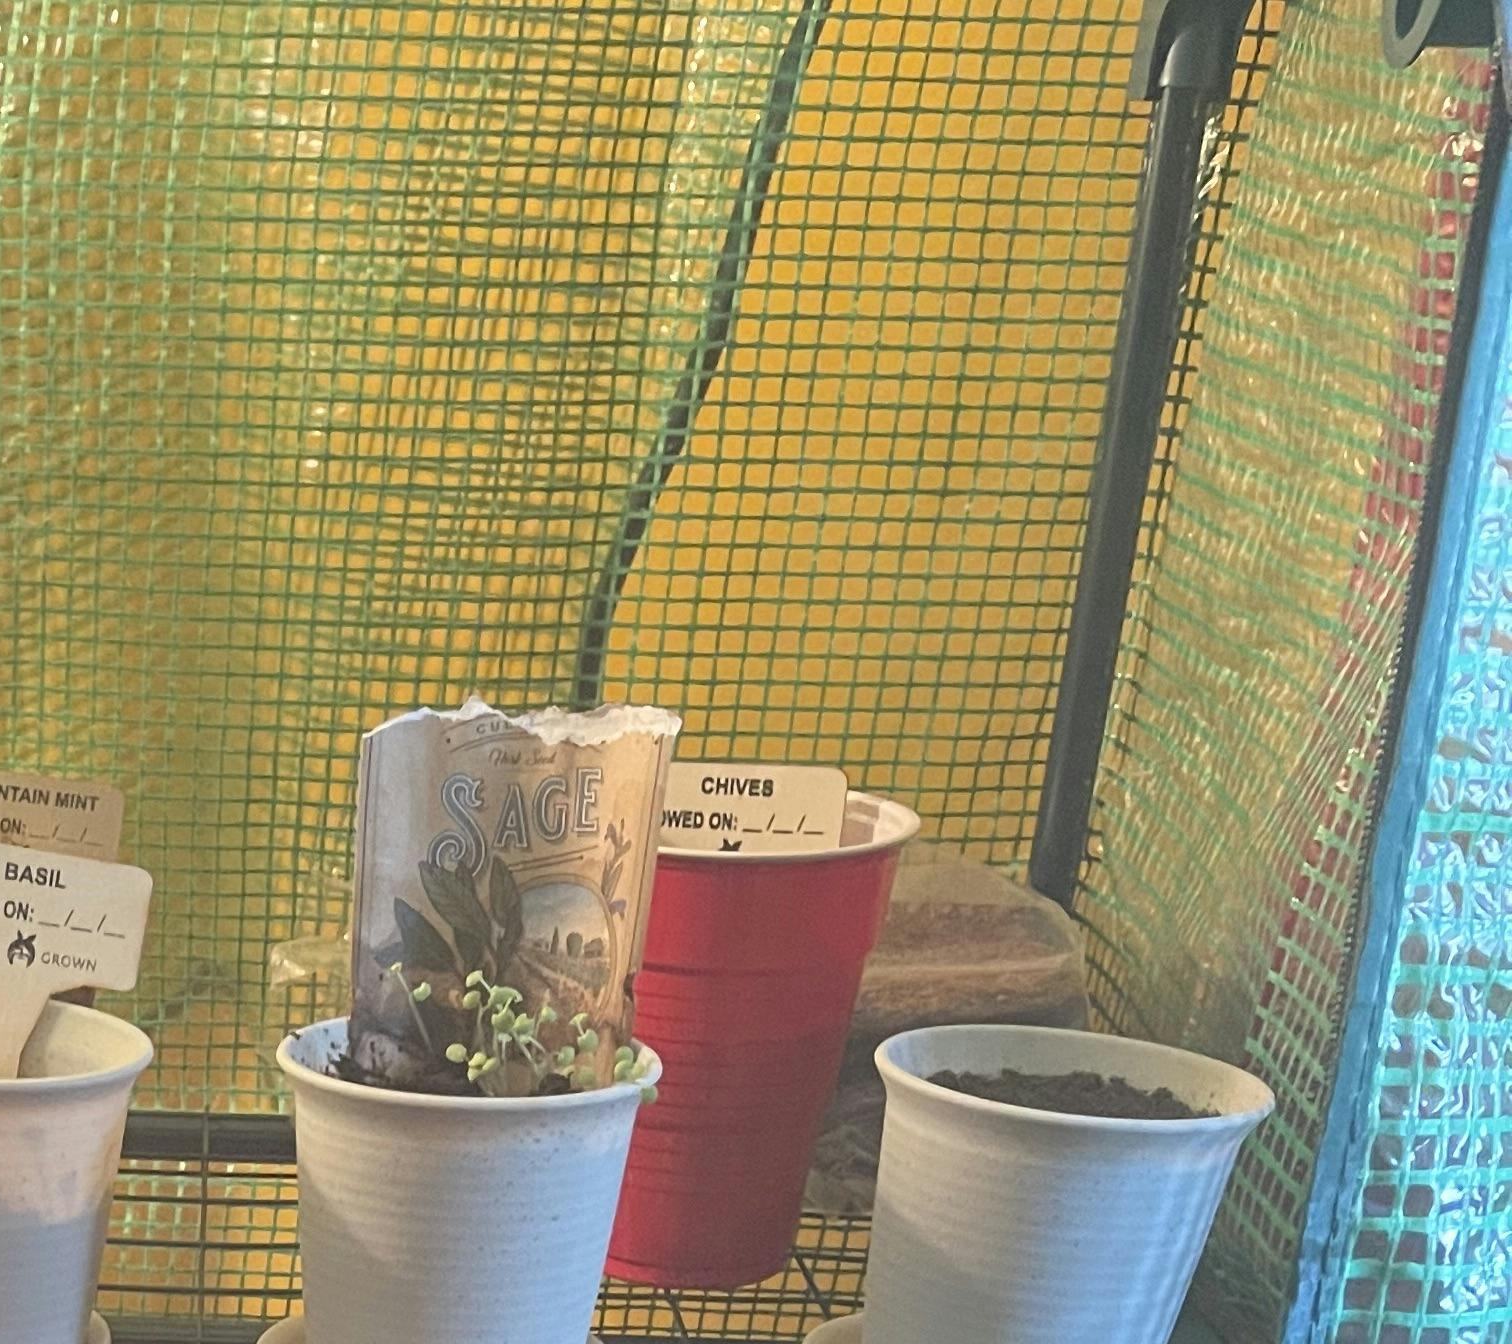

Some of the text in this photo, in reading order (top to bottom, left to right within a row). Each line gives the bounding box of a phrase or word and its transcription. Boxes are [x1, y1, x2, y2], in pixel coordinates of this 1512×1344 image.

[54, 791, 100, 812] MINT
[0, 817, 28, 835] ON:
[427, 767, 603, 877] SAGE
[709, 812, 738, 830] ON:
[4, 862, 66, 890] BASIL
[3, 900, 35, 922] ON:
[40, 951, 98, 973] GROWN
